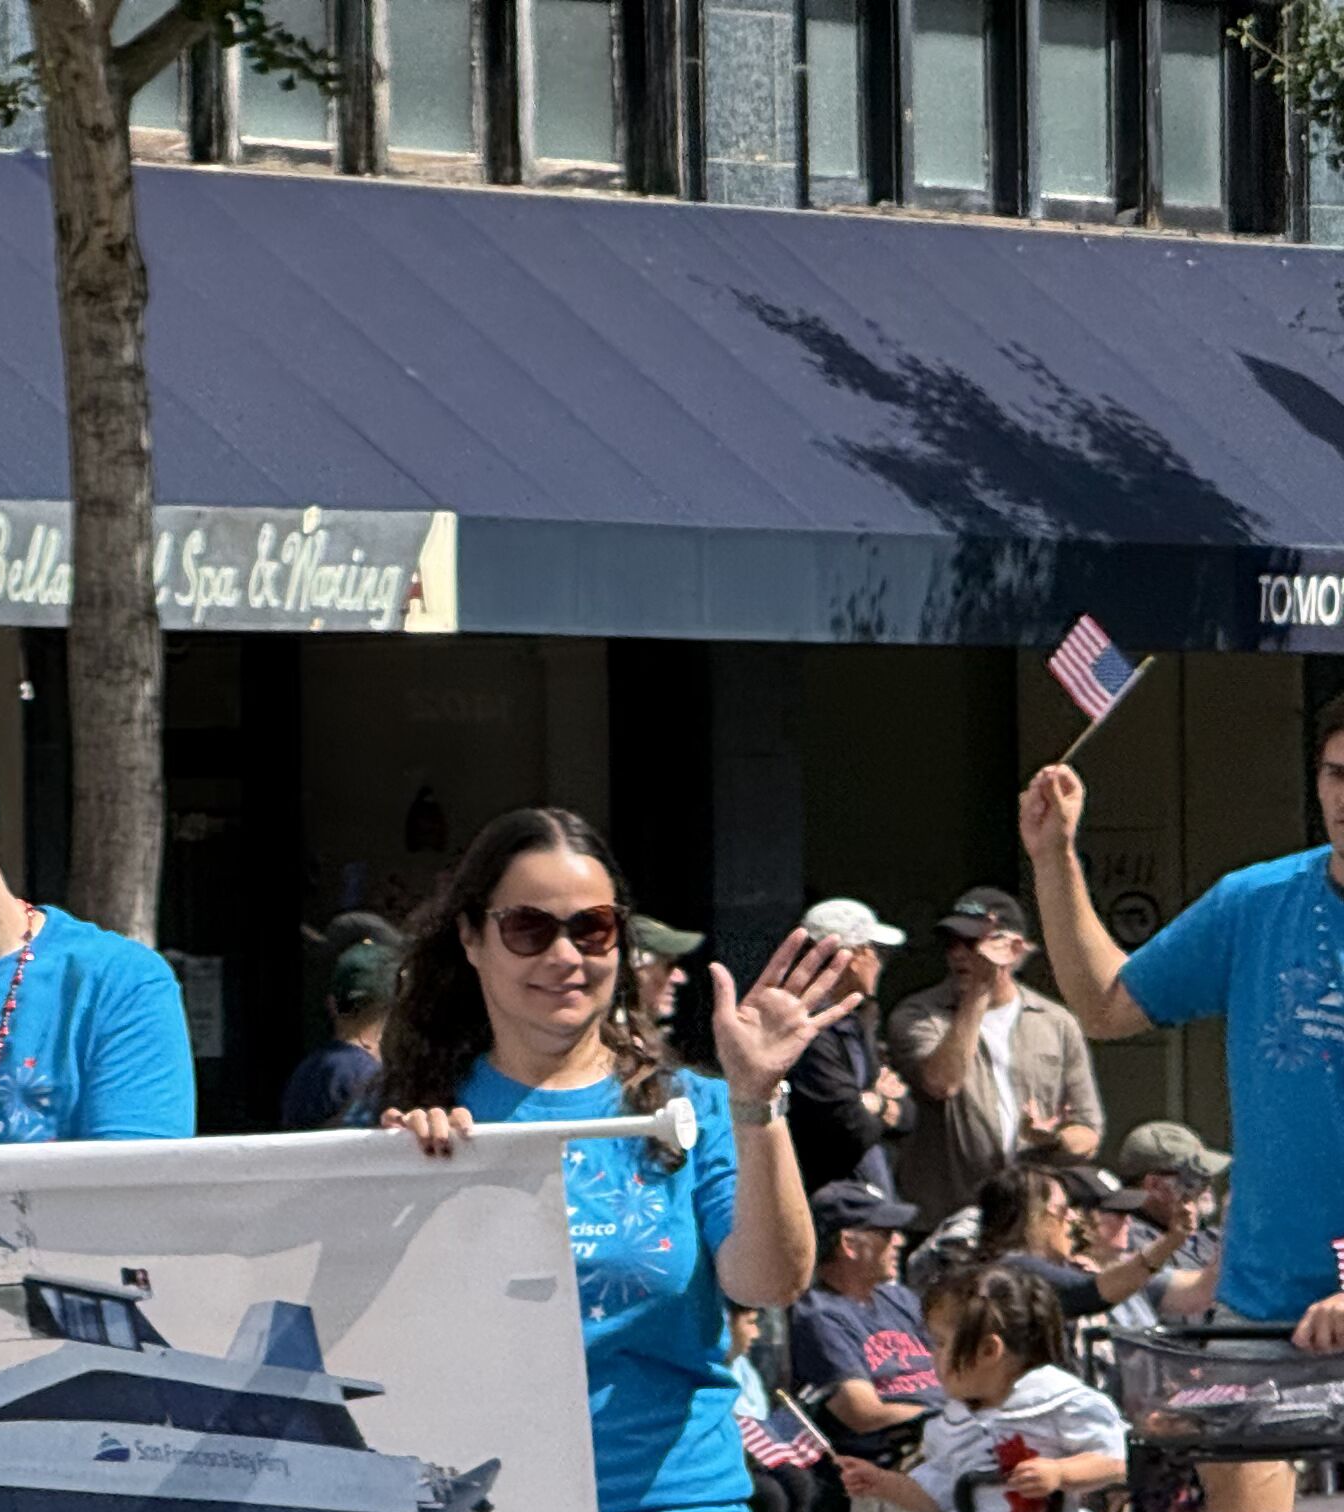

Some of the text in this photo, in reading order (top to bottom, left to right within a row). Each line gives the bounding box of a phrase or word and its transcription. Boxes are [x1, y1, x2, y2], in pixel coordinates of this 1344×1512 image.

[175, 528, 240, 623] Spa
[249, 522, 279, 608] &
[1258, 574, 1344, 626] TOMO
